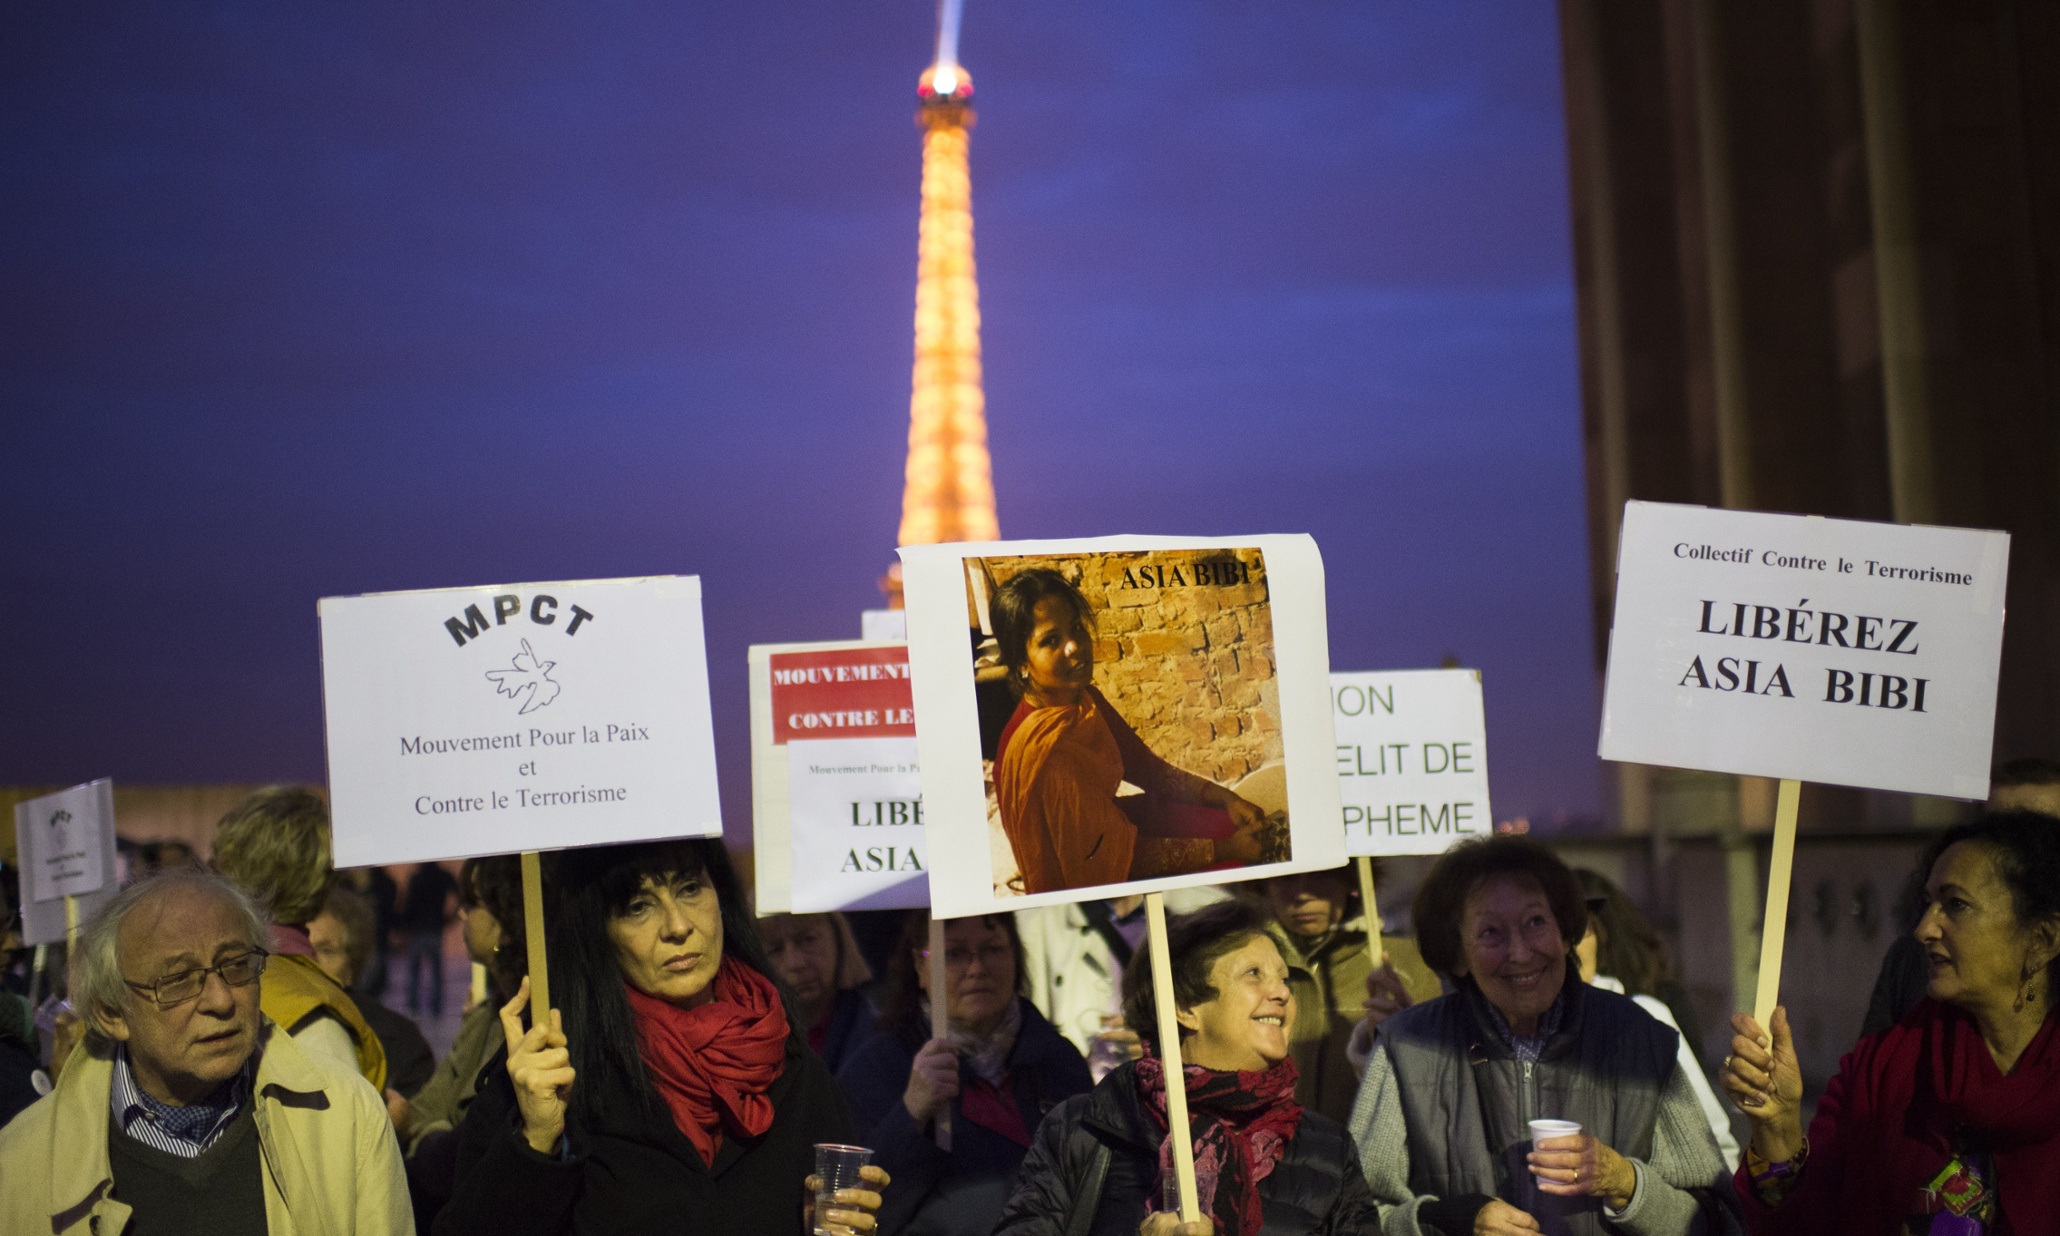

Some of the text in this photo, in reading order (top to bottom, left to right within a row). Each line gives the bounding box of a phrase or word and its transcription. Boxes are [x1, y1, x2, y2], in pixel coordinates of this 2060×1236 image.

[1121, 562, 1251, 590] ASIA BIBI
[1673, 542, 1973, 586] Collectif Contre le Terrorisme
[443, 594, 594, 647] MPCT
[1696, 598, 1920, 656] LIBÉREZ
[774, 663, 910, 686] MOUVEMENT
[1677, 654, 1931, 713] ASIA BIBI
[788, 708, 914, 730] CONTRE LE
[400, 722, 650, 757] Mouvement Pour la Paix
[518, 760, 537, 777] et
[809, 764, 867, 775] Mouvement
[870, 763, 895, 774] Pour
[1424, 742, 1474, 774] DE
[414, 785, 627, 816] Contre le Terrorisme
[1342, 802, 1475, 837] PHEME
[840, 847, 923, 872] ASIA
